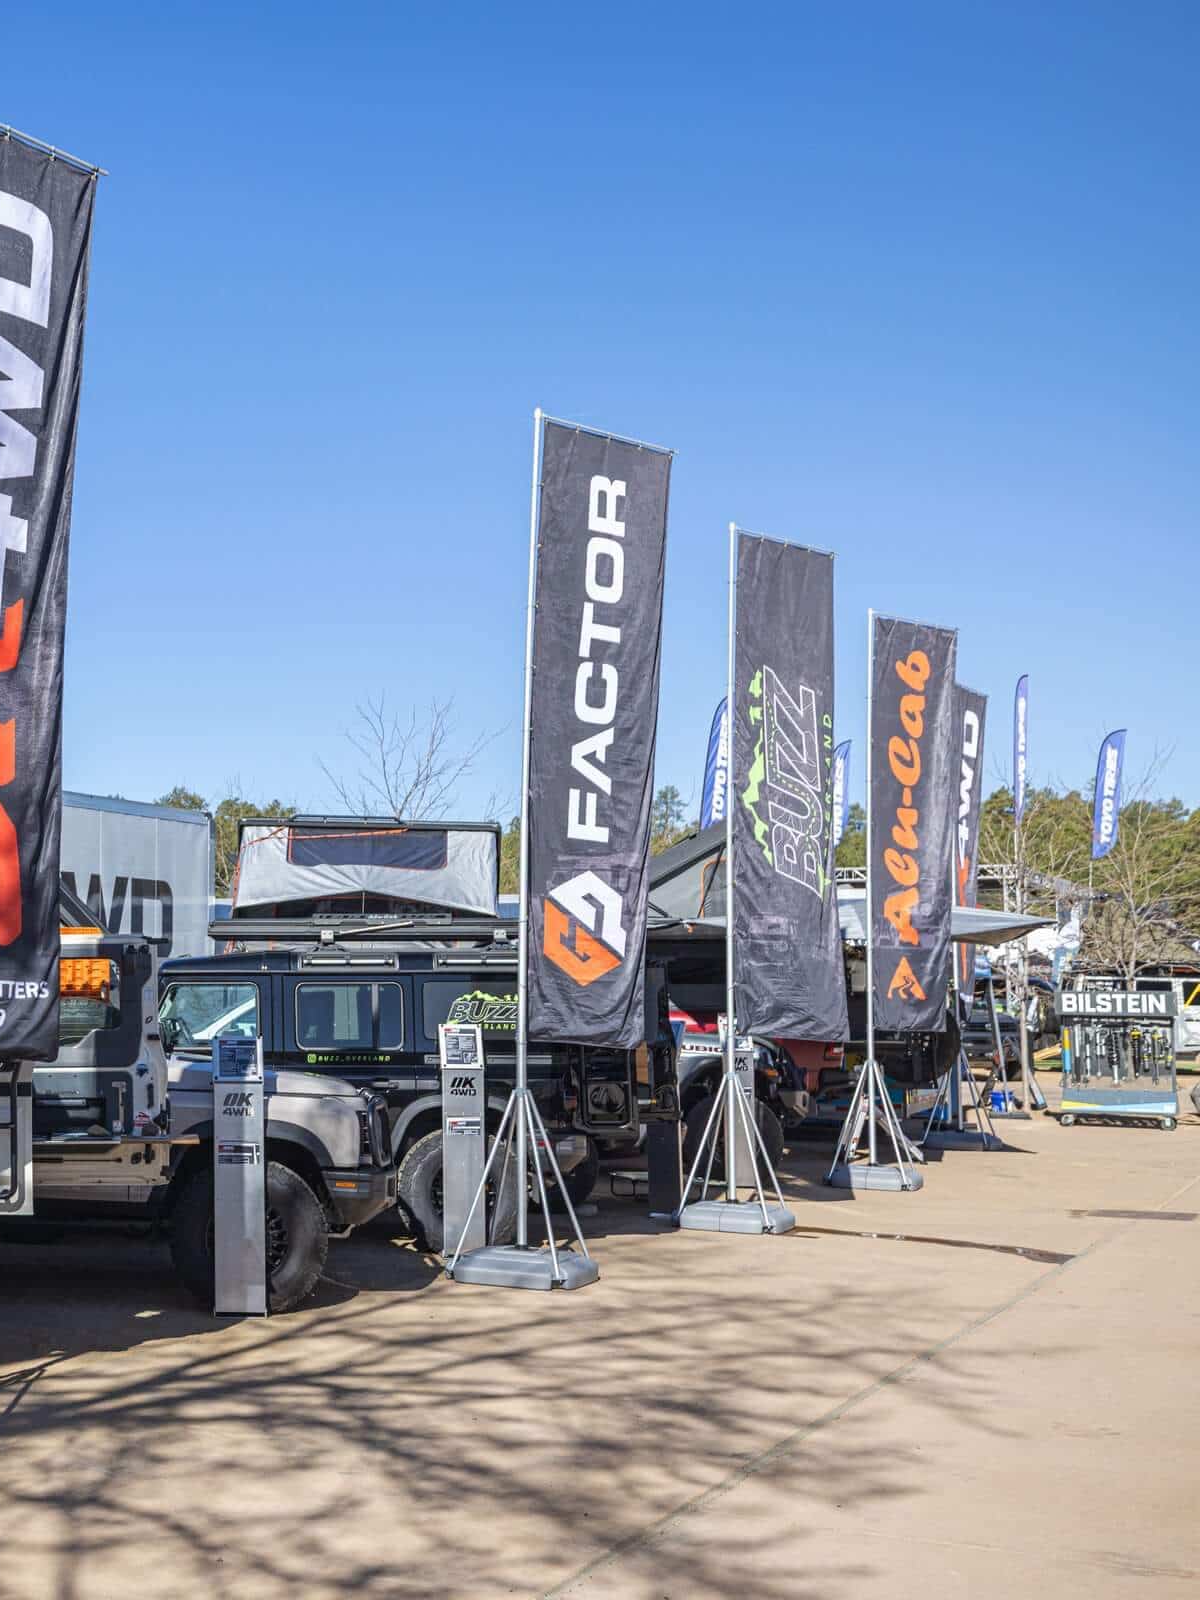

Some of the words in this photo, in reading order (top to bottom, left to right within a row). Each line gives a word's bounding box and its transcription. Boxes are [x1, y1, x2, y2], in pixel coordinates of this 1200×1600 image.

[568, 474, 626, 844] FACTOR
[711, 768, 728, 821] TOYO
[762, 665, 824, 901] BUZZ
[1104, 743, 1118, 797] TIRES
[884, 649, 932, 946] Alu-Cab
[1099, 798, 1114, 844] TOYO
[60, 871, 174, 958] WD
[1061, 993, 1166, 1014] BILSTEIN
[224, 1092, 254, 1107] OK
